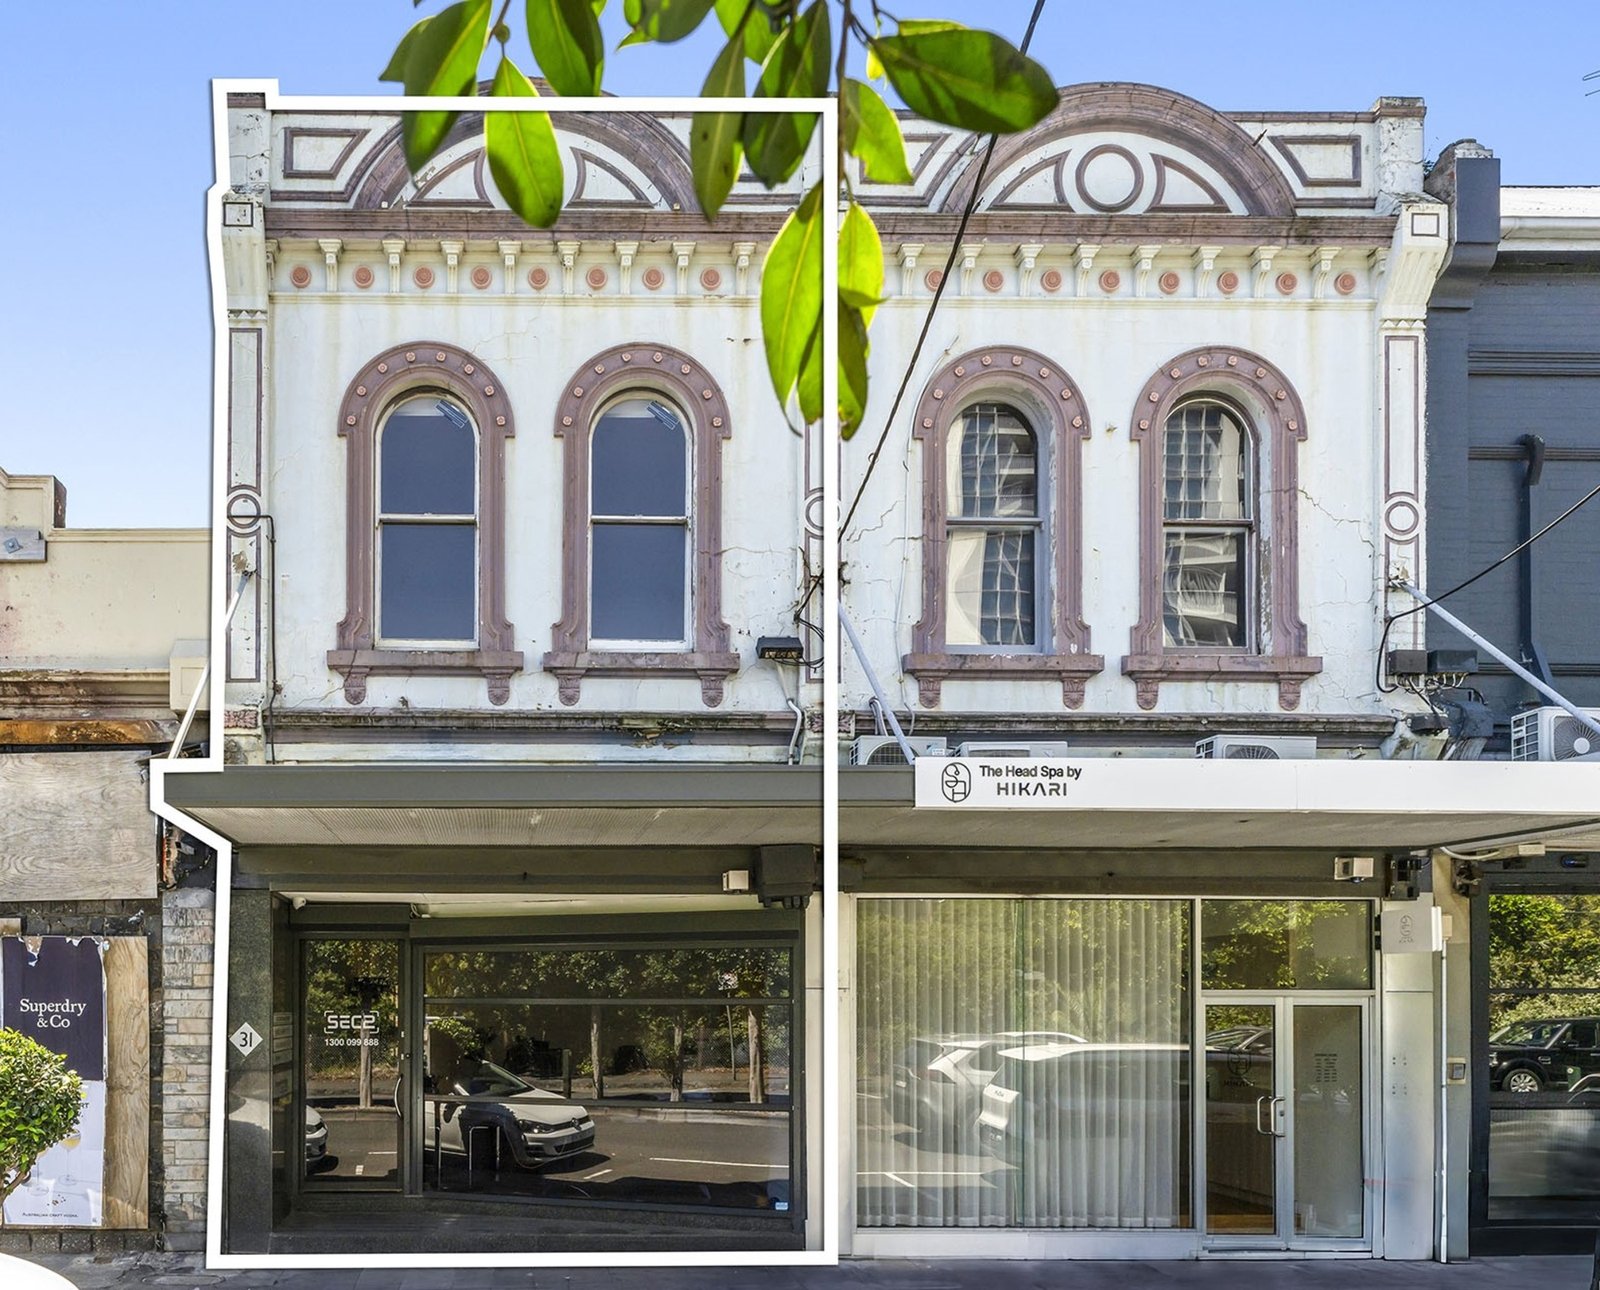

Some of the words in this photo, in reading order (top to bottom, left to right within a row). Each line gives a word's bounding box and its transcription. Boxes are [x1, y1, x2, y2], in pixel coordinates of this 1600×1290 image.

[979, 765, 1003, 777] The
[1005, 765, 1038, 777] Head
[1040, 765, 1064, 779] Spa
[1066, 765, 1082, 780] by
[996, 782, 1067, 796] HIKARI
[20, 998, 87, 1017] Superdry
[239, 1031, 253, 1047] 31
[324, 1038, 345, 1046] 1300
[346, 1038, 362, 1046] 099
[363, 1038, 379, 1046] 888
